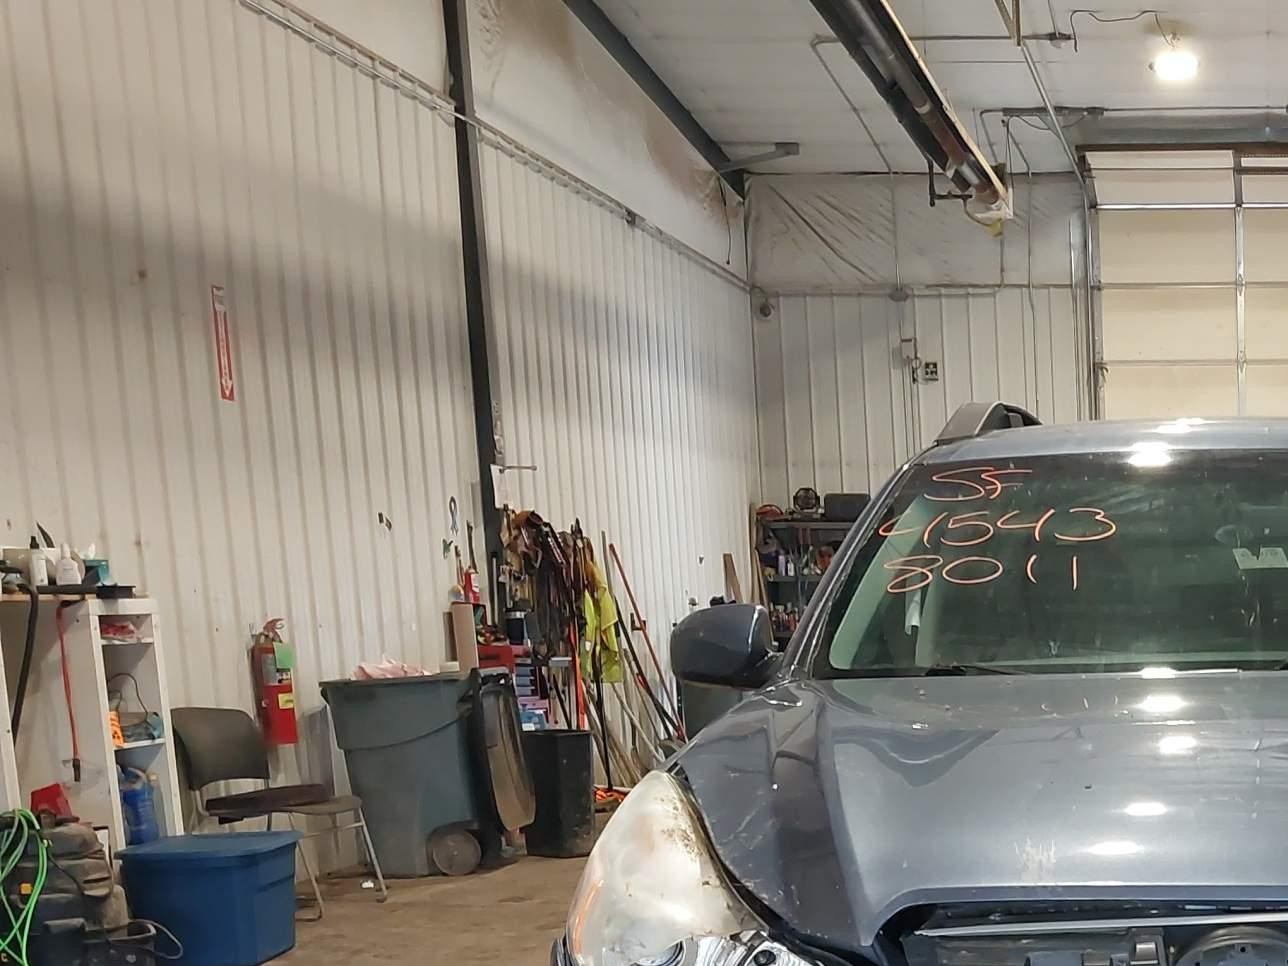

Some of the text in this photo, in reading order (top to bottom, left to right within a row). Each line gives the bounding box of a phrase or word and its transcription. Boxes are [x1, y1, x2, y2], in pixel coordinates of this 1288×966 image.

[923, 466, 1033, 501] SF
[878, 507, 1117, 549] 4543
[883, 553, 1079, 593] 8011
